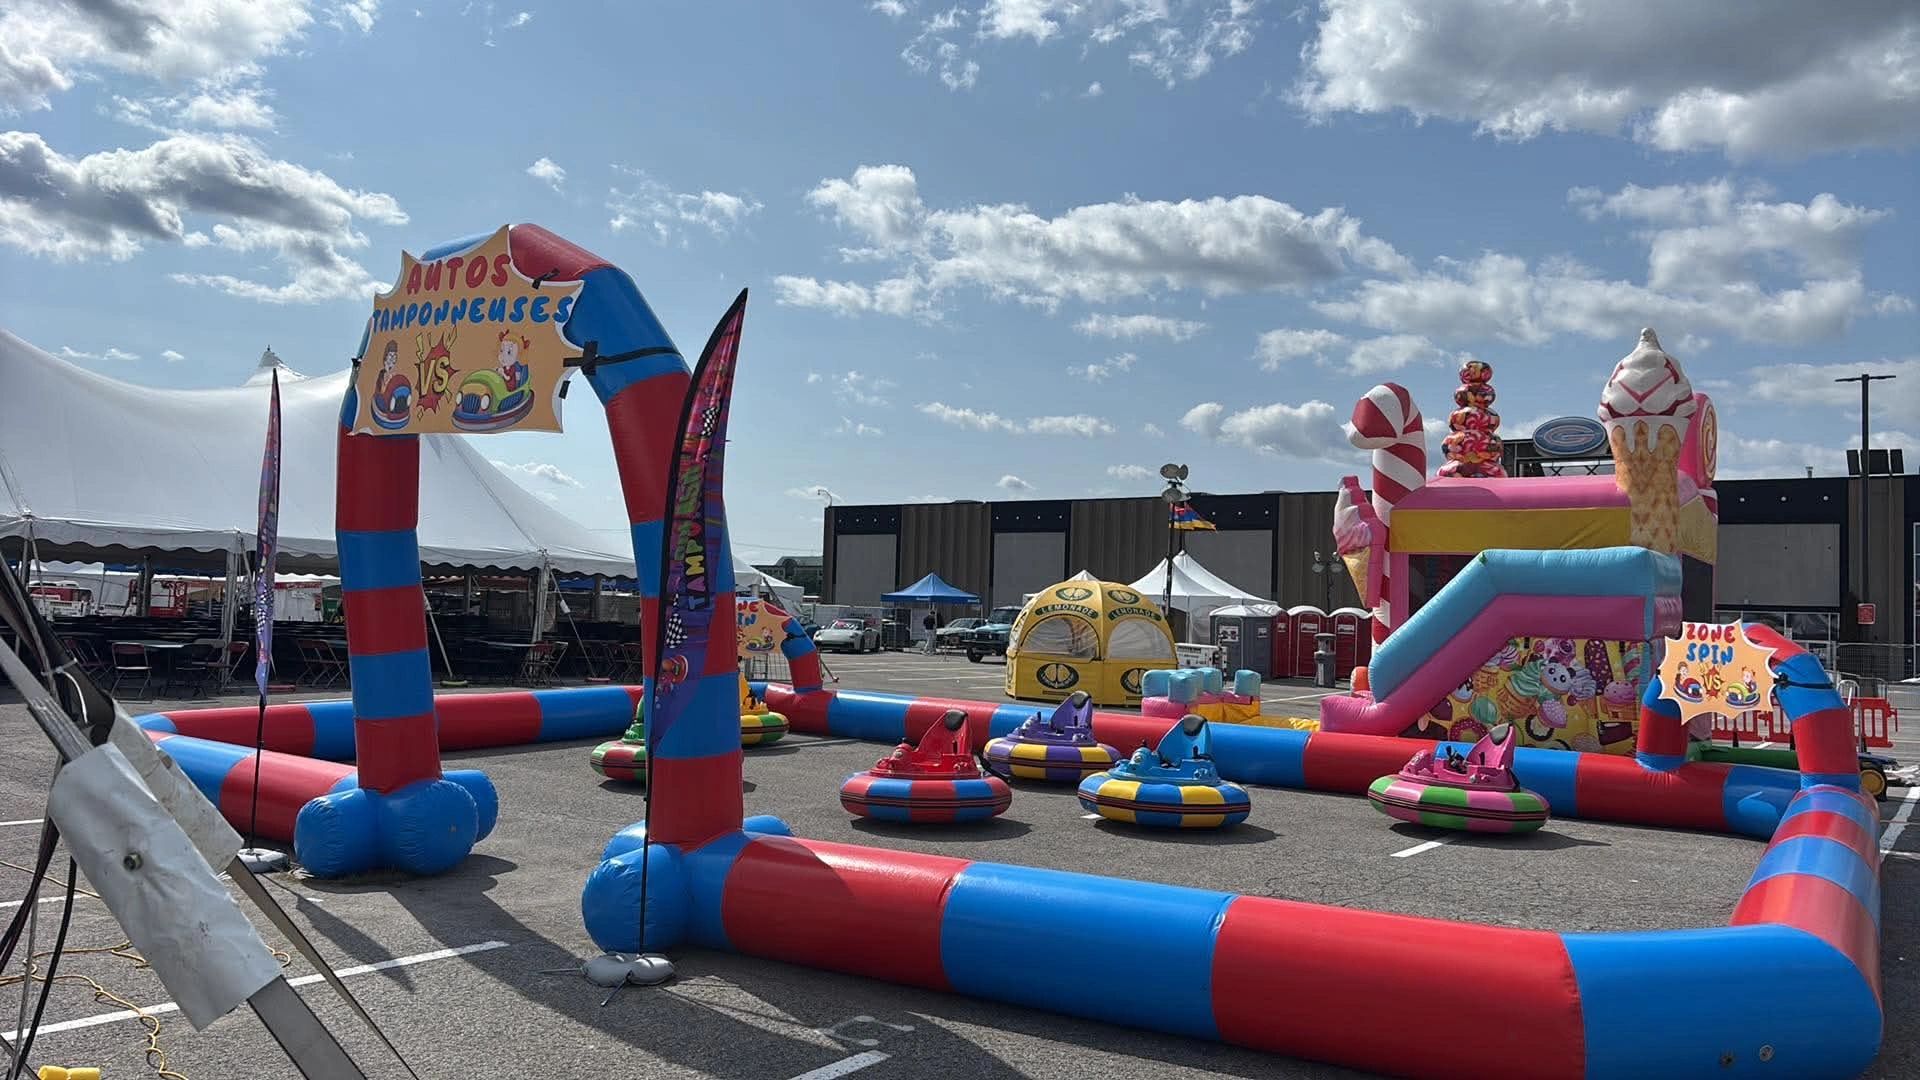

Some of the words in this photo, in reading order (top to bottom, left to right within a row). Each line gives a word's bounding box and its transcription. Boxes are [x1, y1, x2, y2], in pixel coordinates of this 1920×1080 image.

[407, 254, 511, 295] AUTOS
[373, 296, 574, 333] TAMPONNEUSES
[419, 357, 450, 396] VS
[1040, 603, 1094, 618] LEMONADE
[1111, 607, 1156, 618] LEMONADE
[1686, 624, 1735, 643] ZONE
[1686, 643, 1733, 665] SPIN
[1704, 675, 1722, 691] VS
